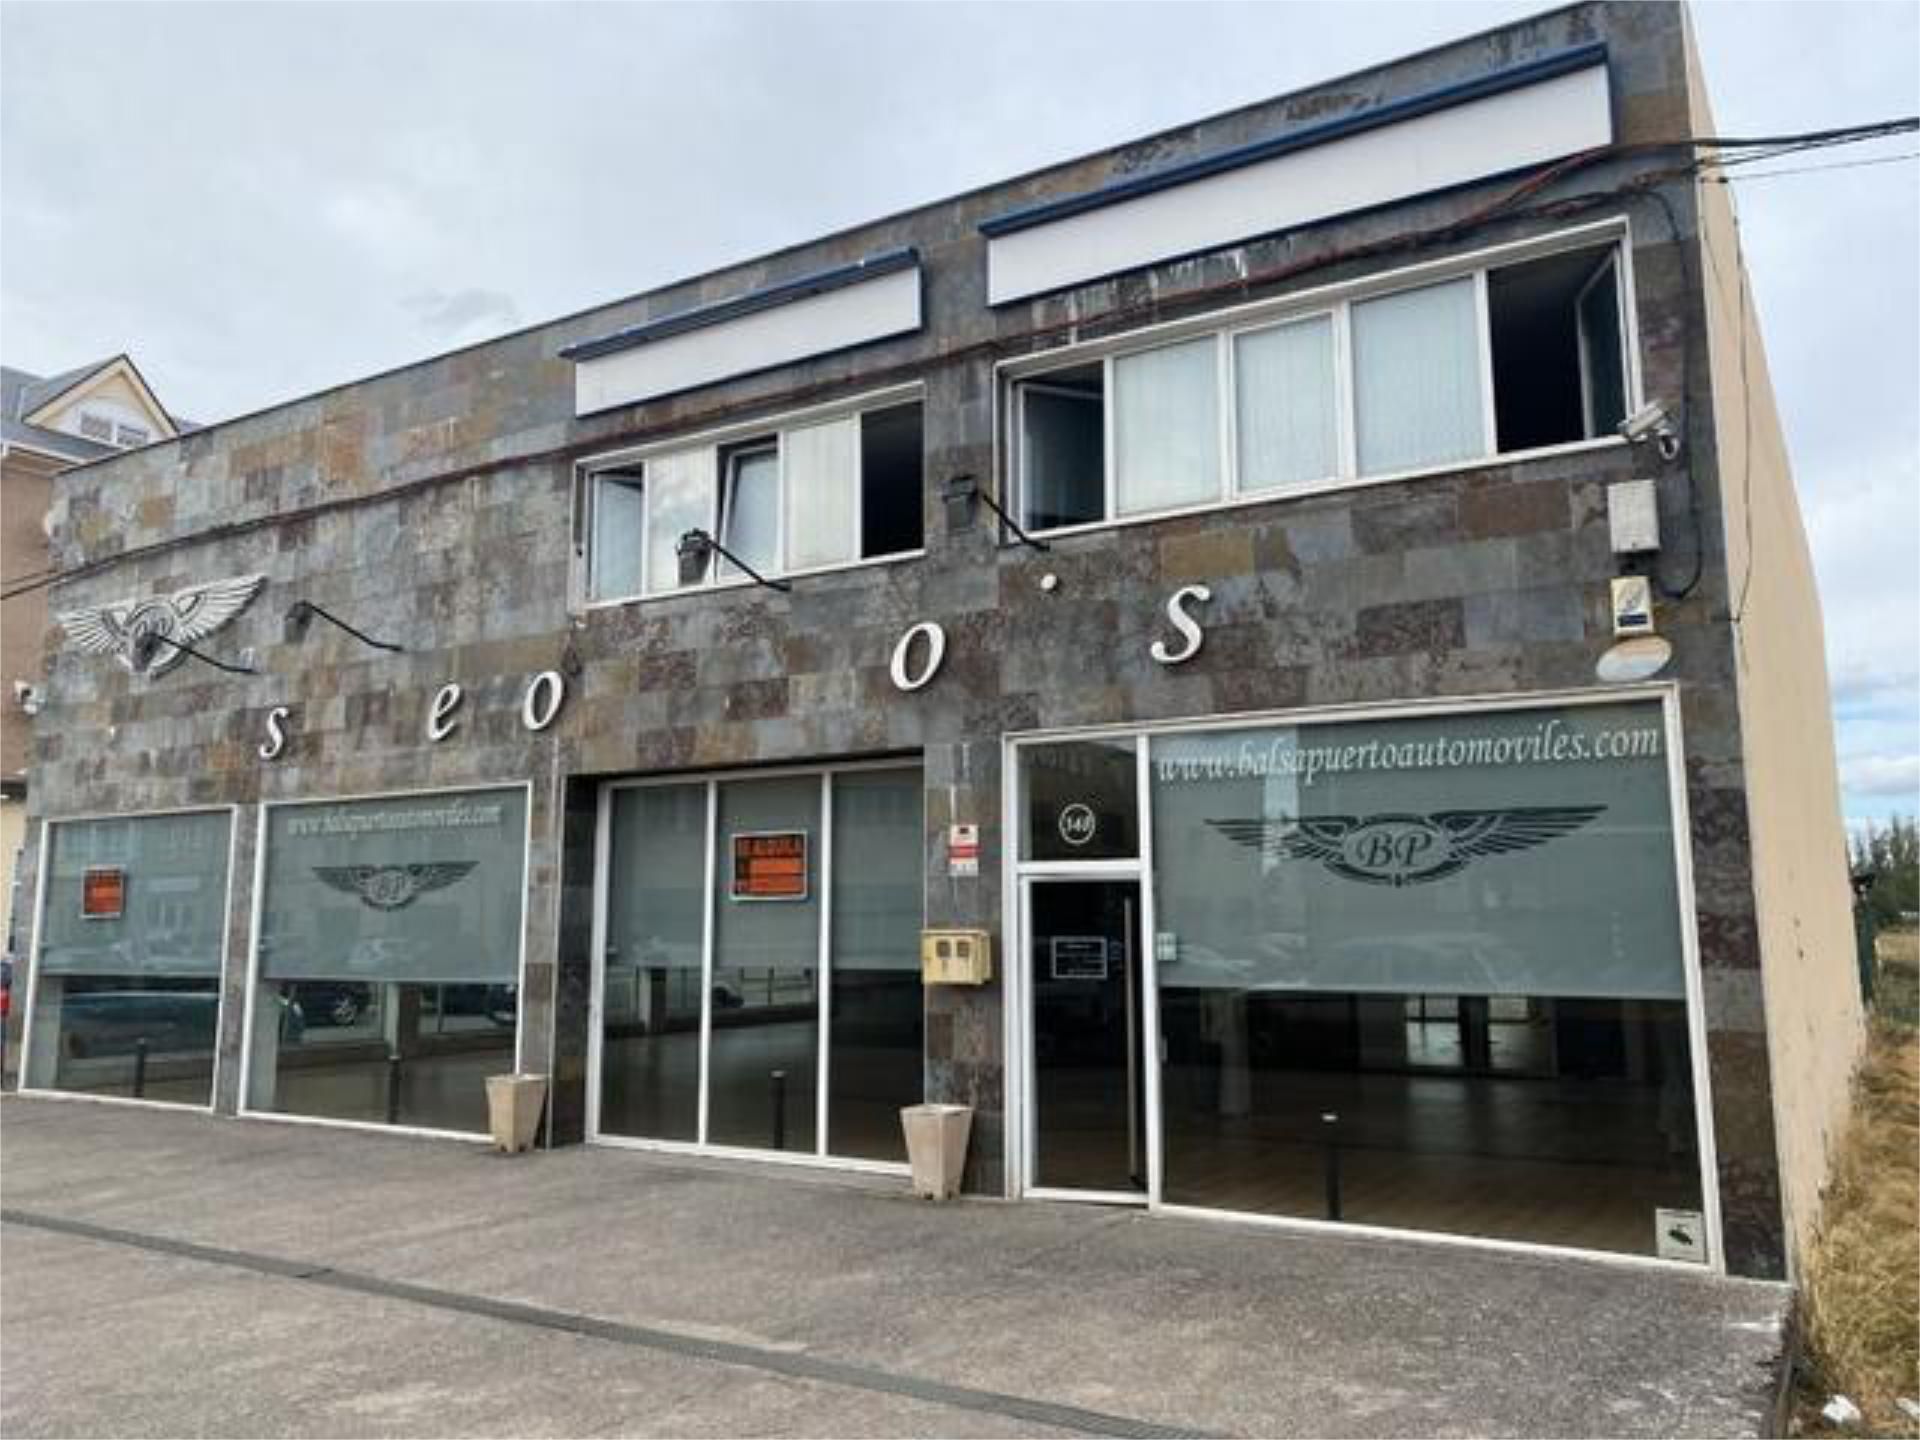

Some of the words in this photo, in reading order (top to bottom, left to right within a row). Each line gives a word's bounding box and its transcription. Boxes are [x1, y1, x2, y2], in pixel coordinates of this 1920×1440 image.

[259, 706, 289, 758] s
[428, 683, 460, 740] e
[523, 671, 563, 730] o
[890, 622, 946, 691] o
[1150, 585, 1210, 663] s
[1157, 720, 1659, 785] www.balsapuertoautomoviles.com
[1356, 830, 1432, 867] BP
